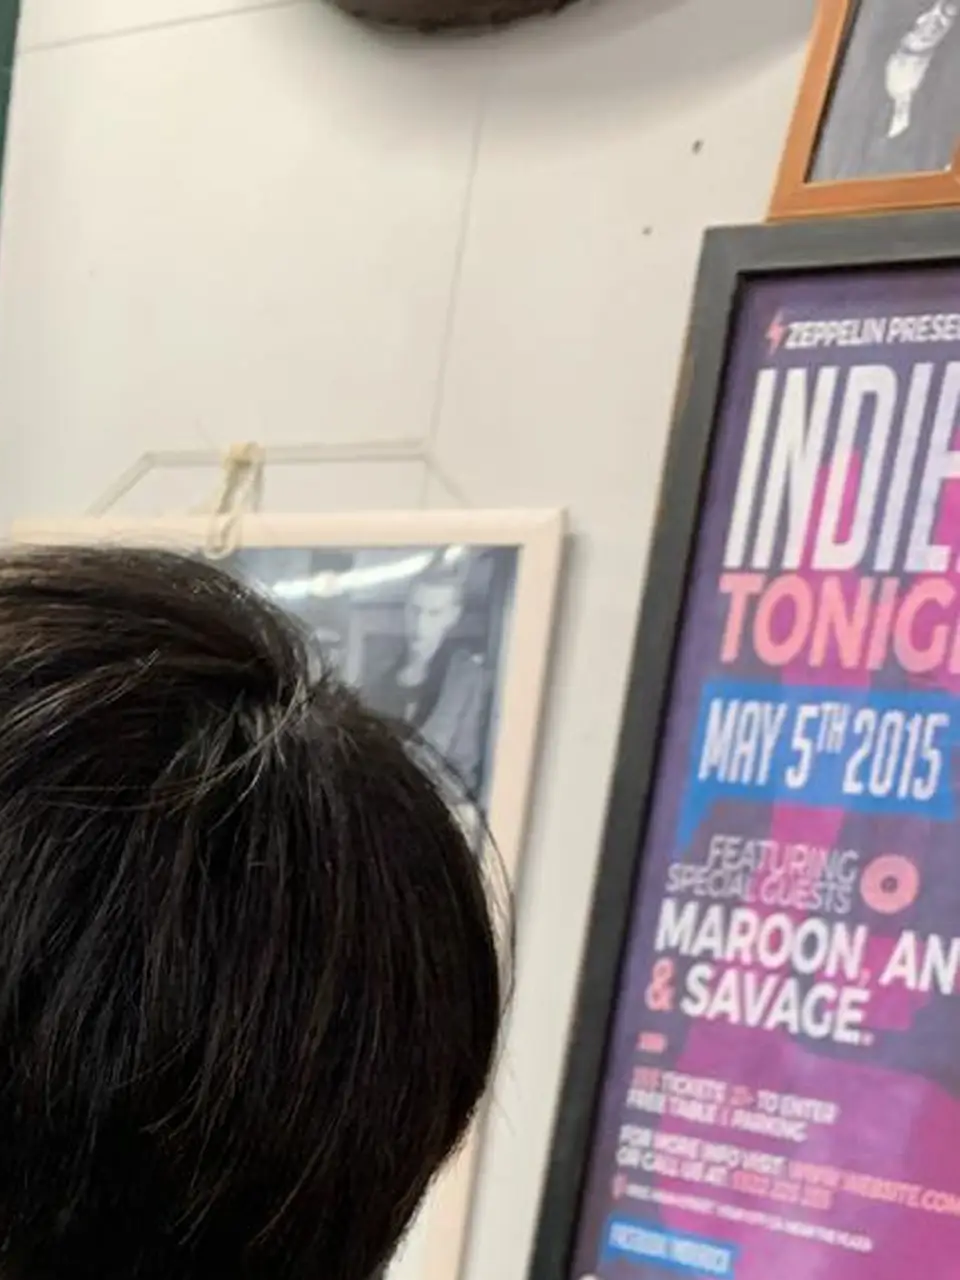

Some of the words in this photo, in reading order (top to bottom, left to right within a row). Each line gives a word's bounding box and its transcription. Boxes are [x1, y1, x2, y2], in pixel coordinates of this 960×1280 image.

[785, 317, 887, 350] ZEPPELIN
[723, 362, 960, 572] INDIE
[698, 698, 788, 786] MAY
[784, 702, 851, 789] 5TH
[842, 708, 950, 801] 2015
[707, 835, 860, 882] FEATURING
[666, 862, 756, 902] SPECIAL
[758, 870, 853, 914] GUESTS
[646, 957, 675, 1011] &
